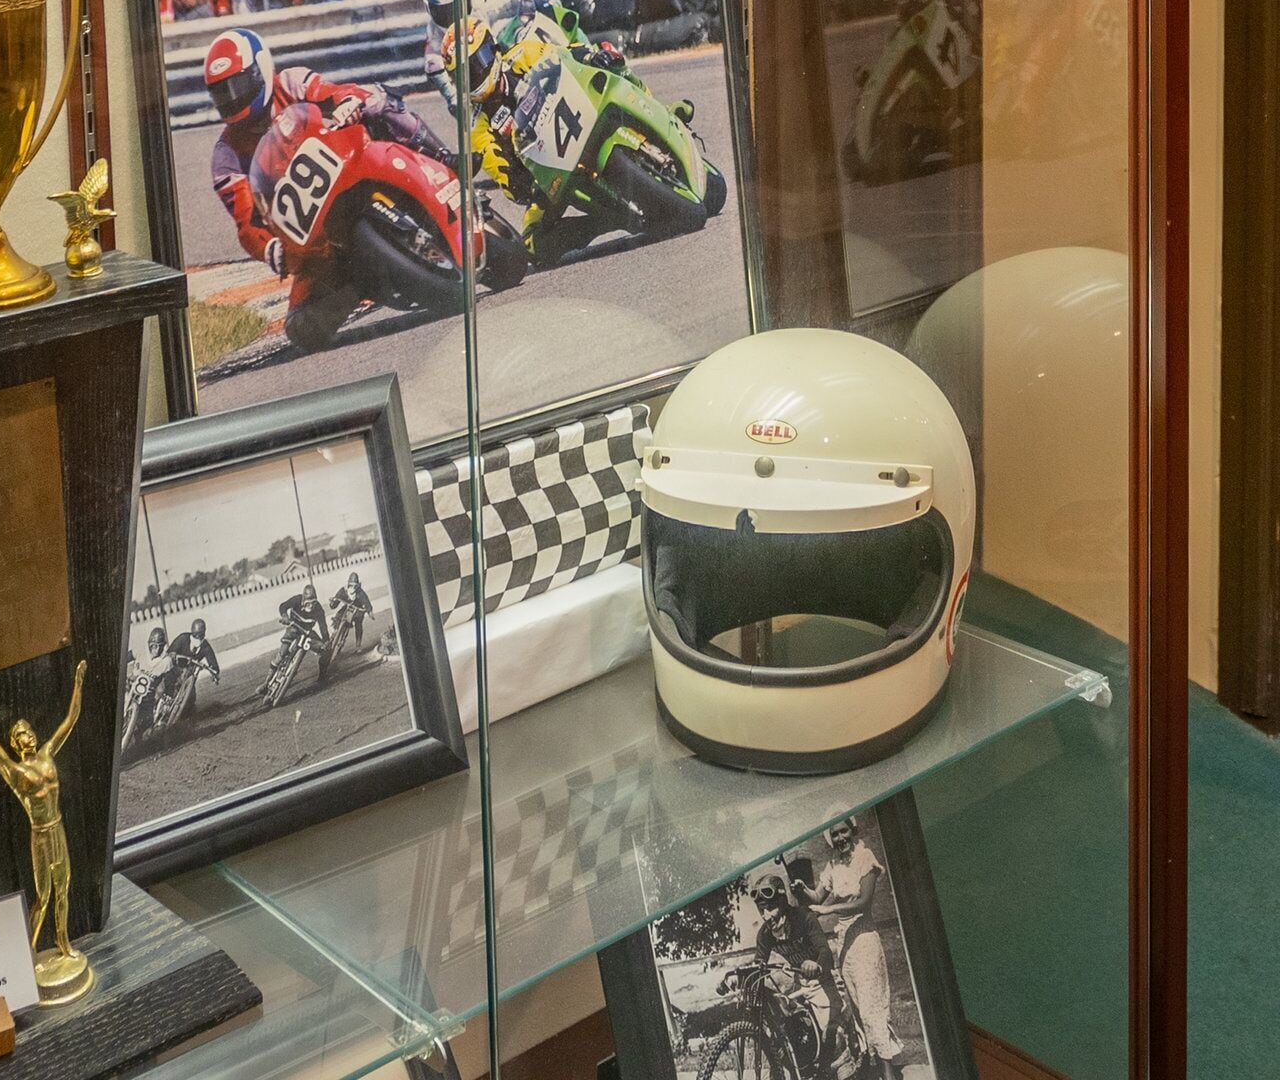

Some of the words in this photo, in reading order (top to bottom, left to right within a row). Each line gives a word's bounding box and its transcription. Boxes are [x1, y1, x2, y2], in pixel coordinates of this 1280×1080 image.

[554, 96, 583, 159] 4
[752, 424, 792, 439] BELL
[297, 634, 312, 651] 16
